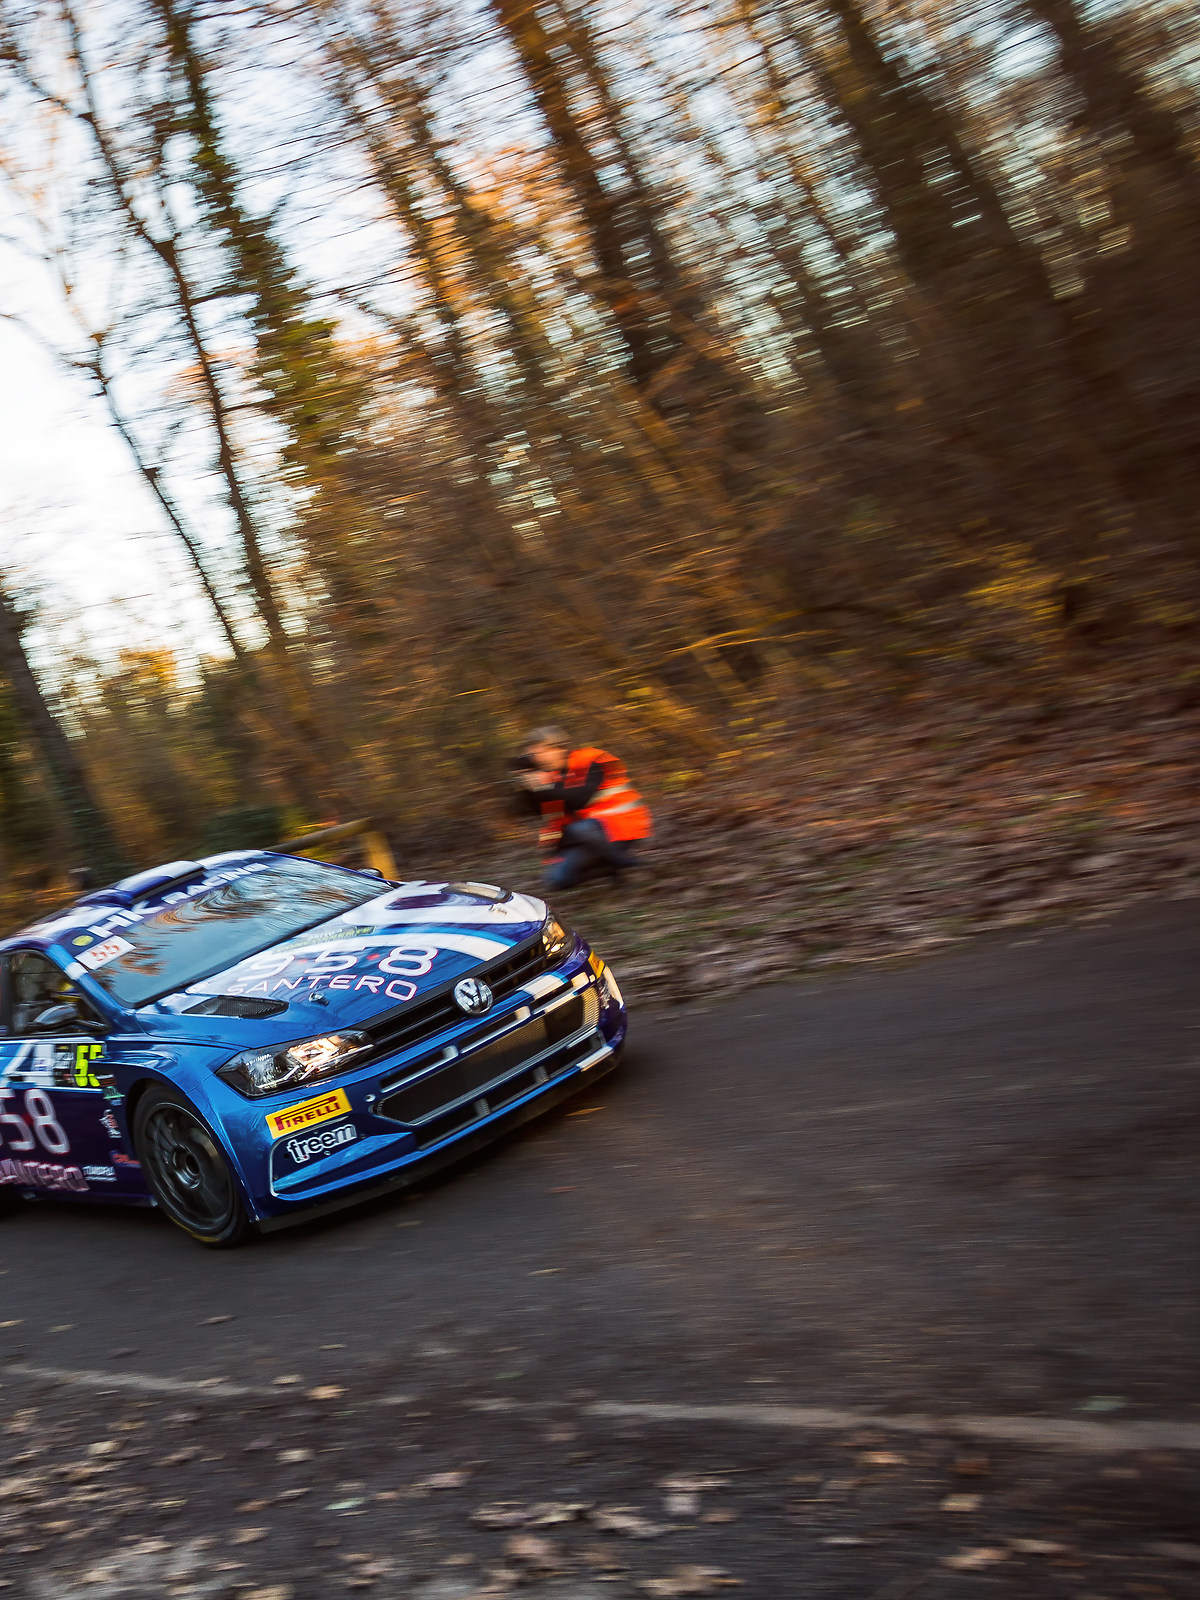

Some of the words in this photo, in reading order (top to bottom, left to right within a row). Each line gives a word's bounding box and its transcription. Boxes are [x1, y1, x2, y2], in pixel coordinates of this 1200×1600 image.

[161, 862, 270, 905] RACING
[90, 943, 120, 962] 55
[227, 974, 418, 1001] SANTERO
[74, 1044, 105, 1087] 55
[274, 1096, 340, 1131] PIRELLI
[286, 1124, 357, 1163] freem
